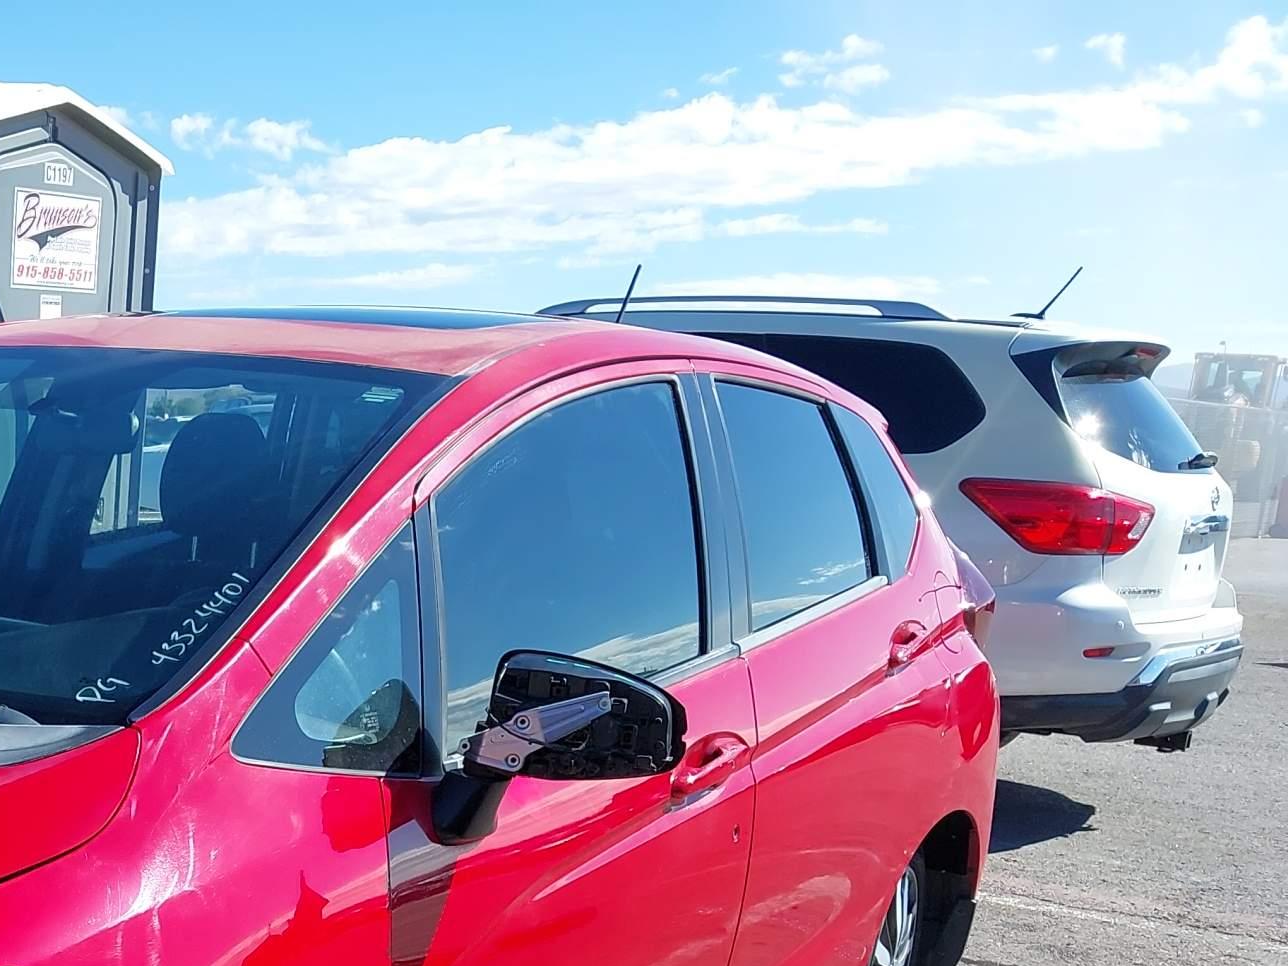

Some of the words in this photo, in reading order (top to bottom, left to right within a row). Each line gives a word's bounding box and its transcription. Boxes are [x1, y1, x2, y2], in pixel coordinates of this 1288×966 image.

[46, 165, 72, 183] C1197
[17, 193, 97, 238] Brunson's
[16, 264, 93, 283] 915-858-5511
[152, 572, 250, 665] 43324401
